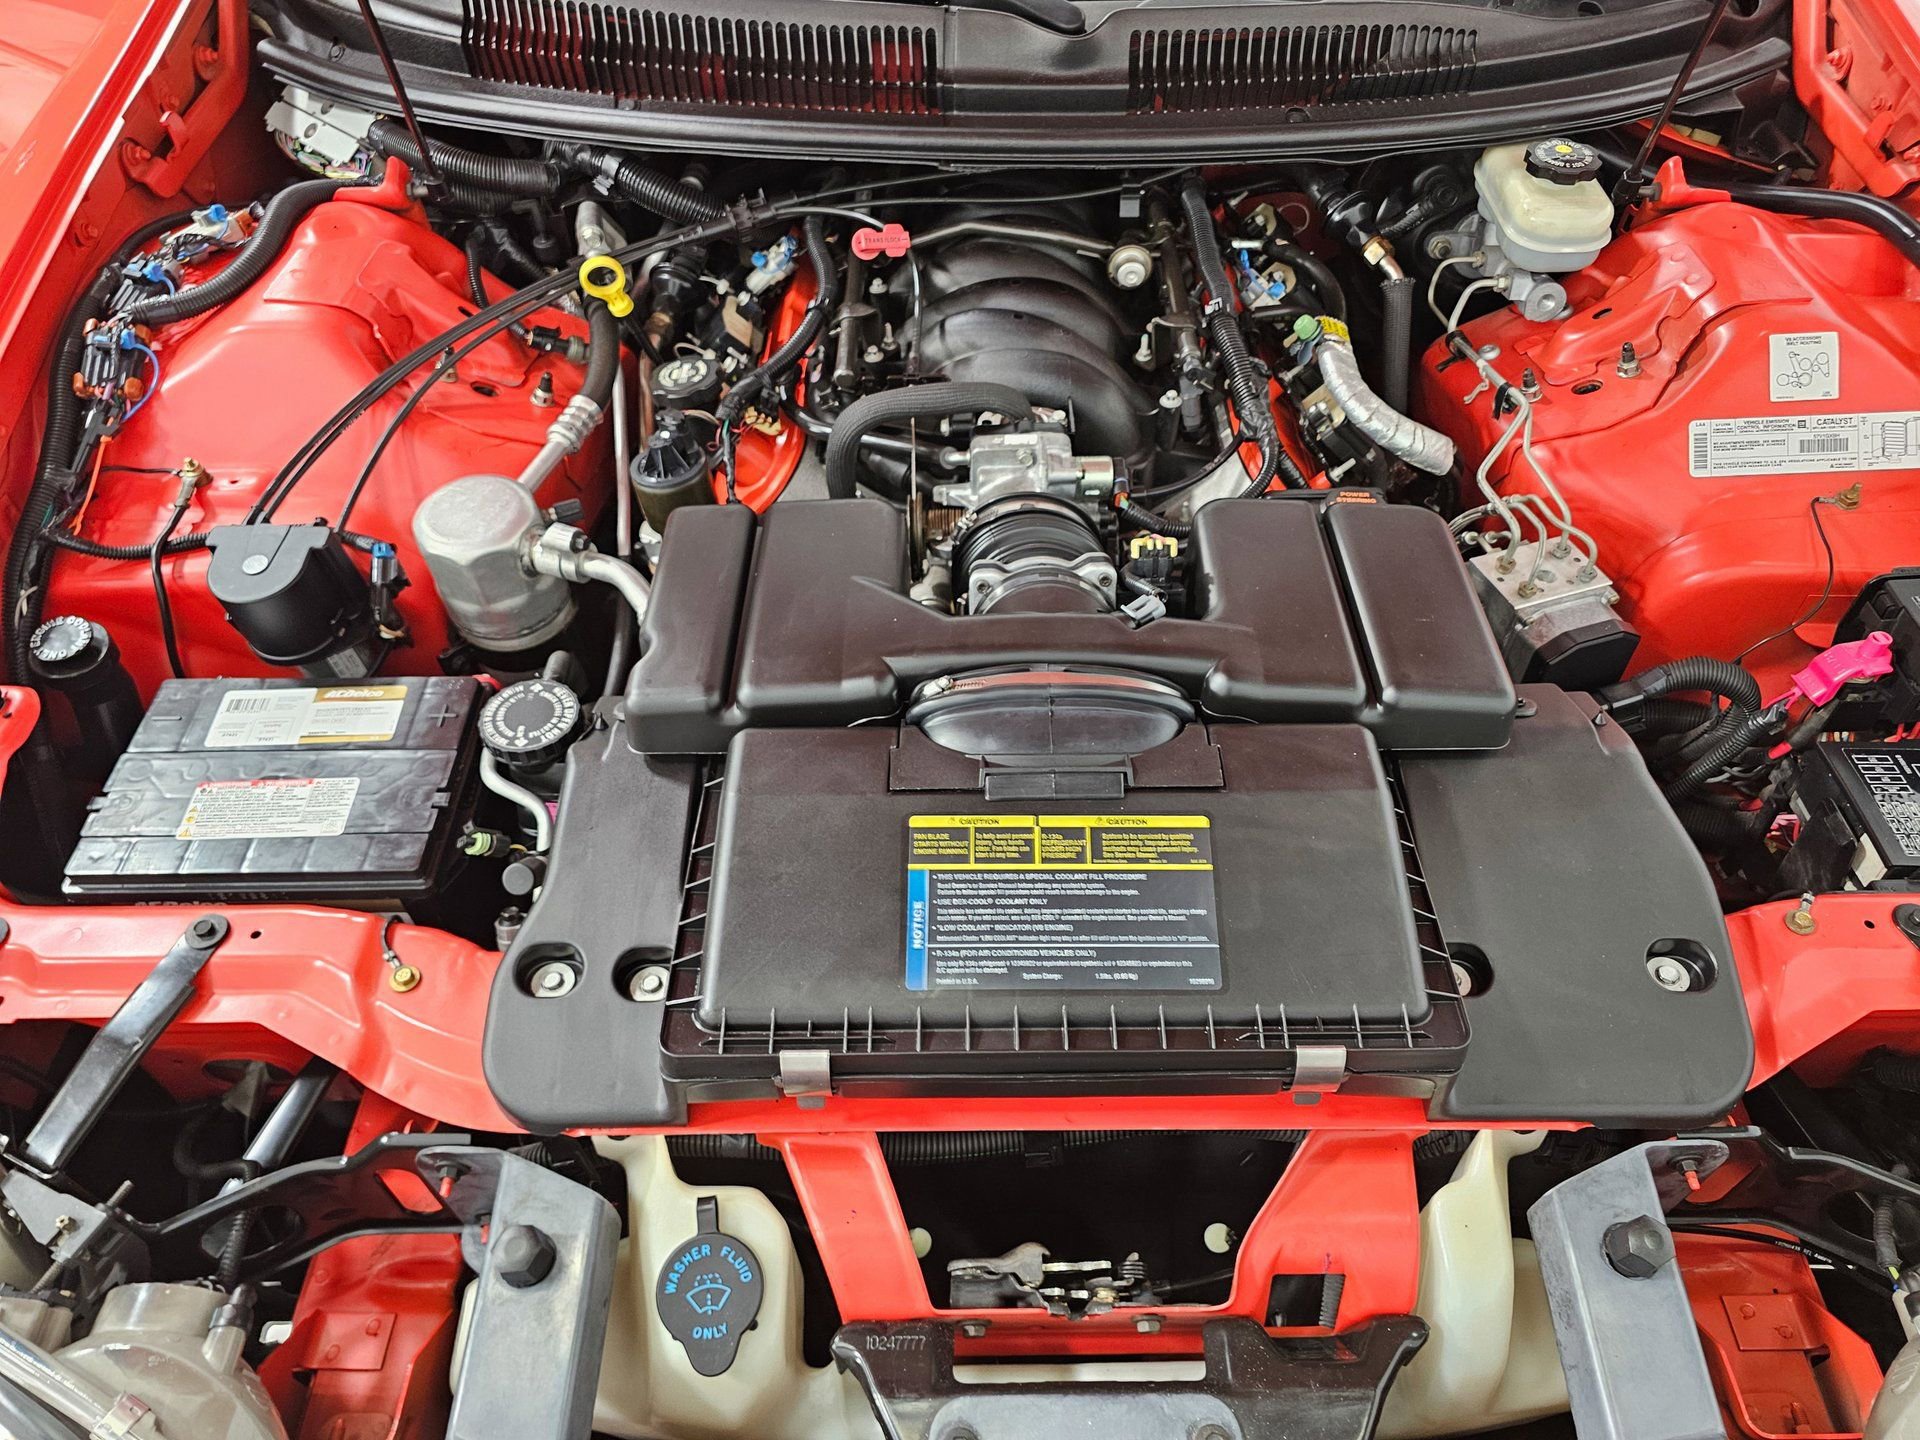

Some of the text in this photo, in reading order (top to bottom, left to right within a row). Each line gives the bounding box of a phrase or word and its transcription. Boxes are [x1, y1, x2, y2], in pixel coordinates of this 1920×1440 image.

[1816, 417, 1853, 425] CATALYST
[30, 615, 64, 648] ENGINE
[33, 647, 67, 661] ONLY
[913, 901, 925, 949] NOTICE
[664, 1244, 753, 1339] WASHER FLUID ONLY
[866, 1335, 926, 1351] 10247777
